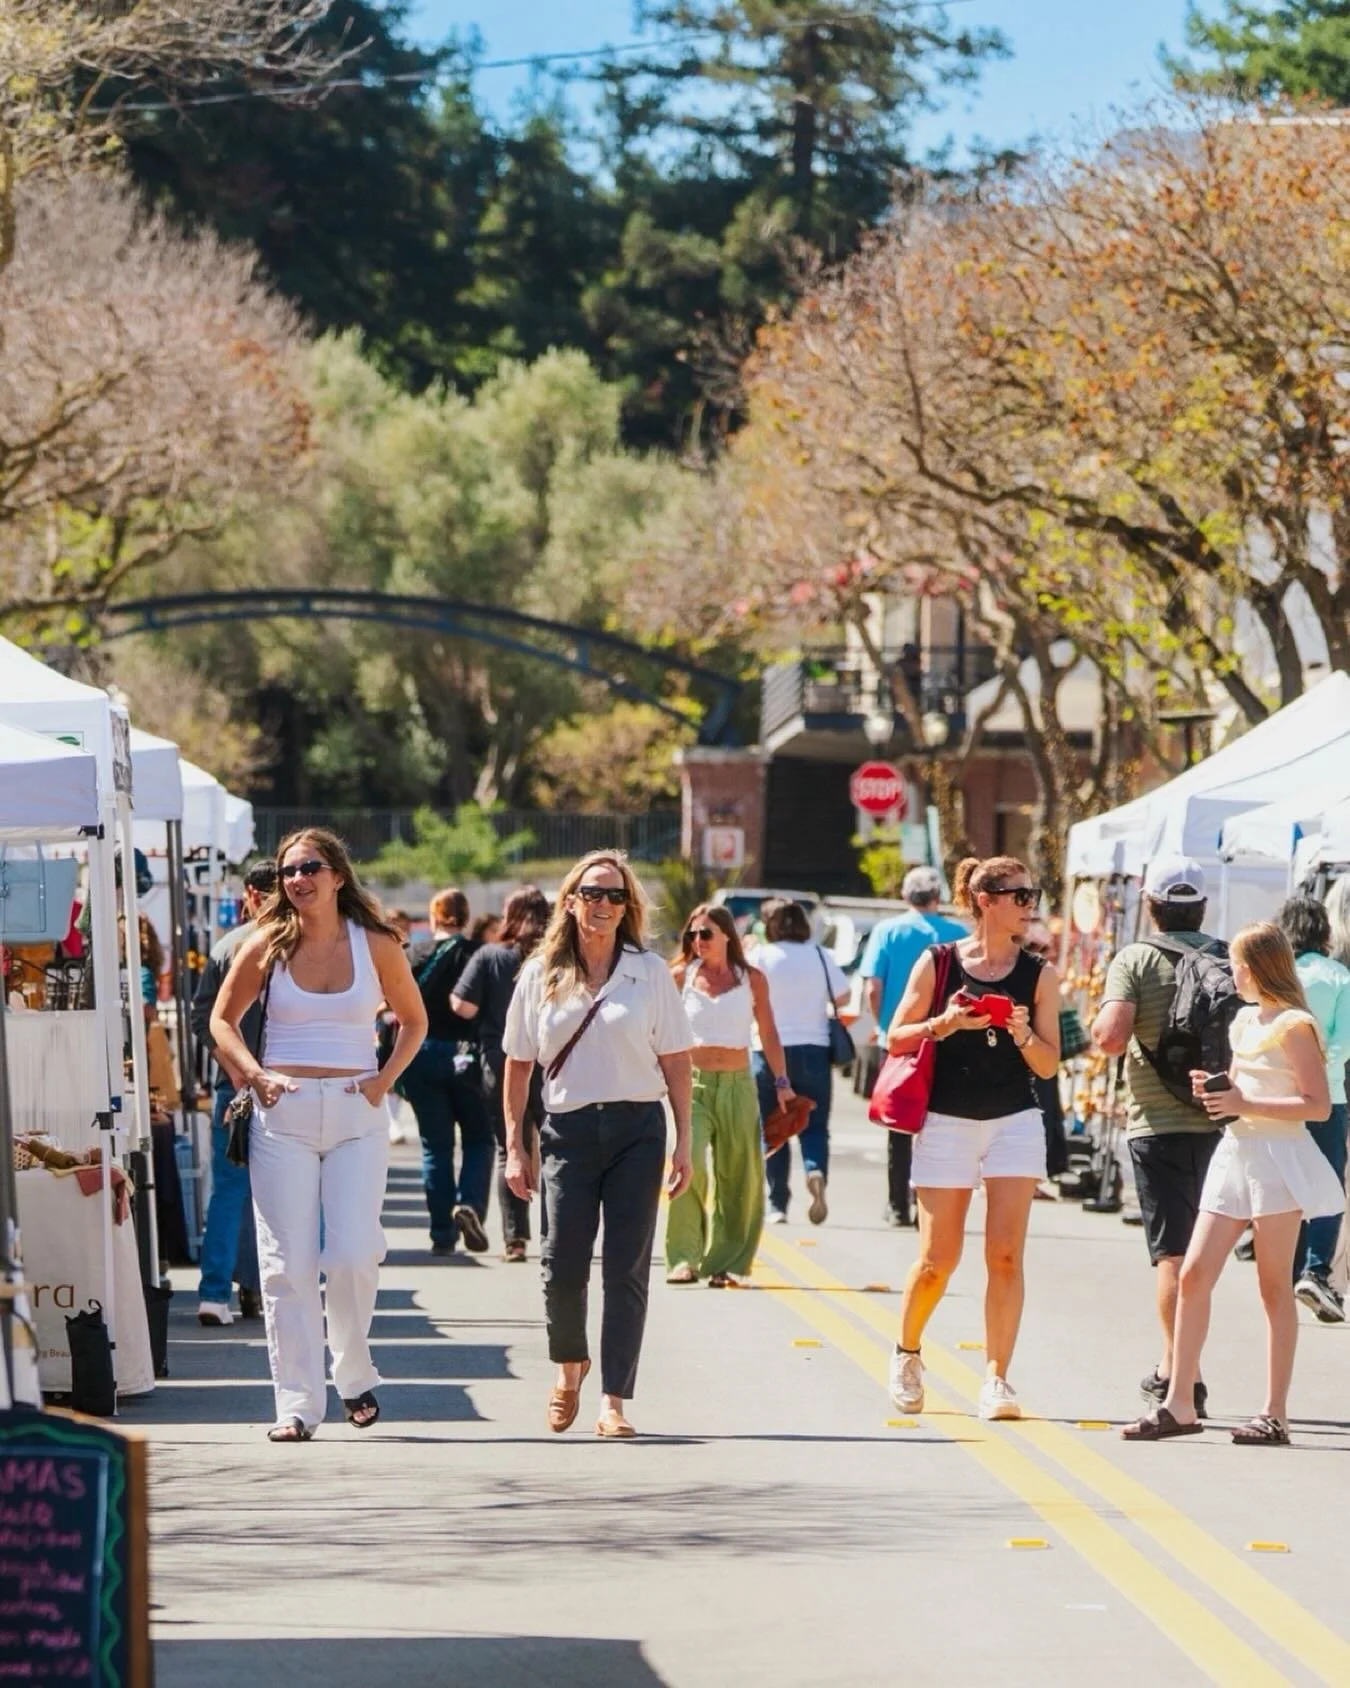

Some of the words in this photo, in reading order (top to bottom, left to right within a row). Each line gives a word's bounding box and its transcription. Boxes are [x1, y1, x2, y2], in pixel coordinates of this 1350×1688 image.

[855, 778, 902, 799] STOP
[34, 1284, 74, 1308] ra
[0, 1458, 85, 1498] MAS
